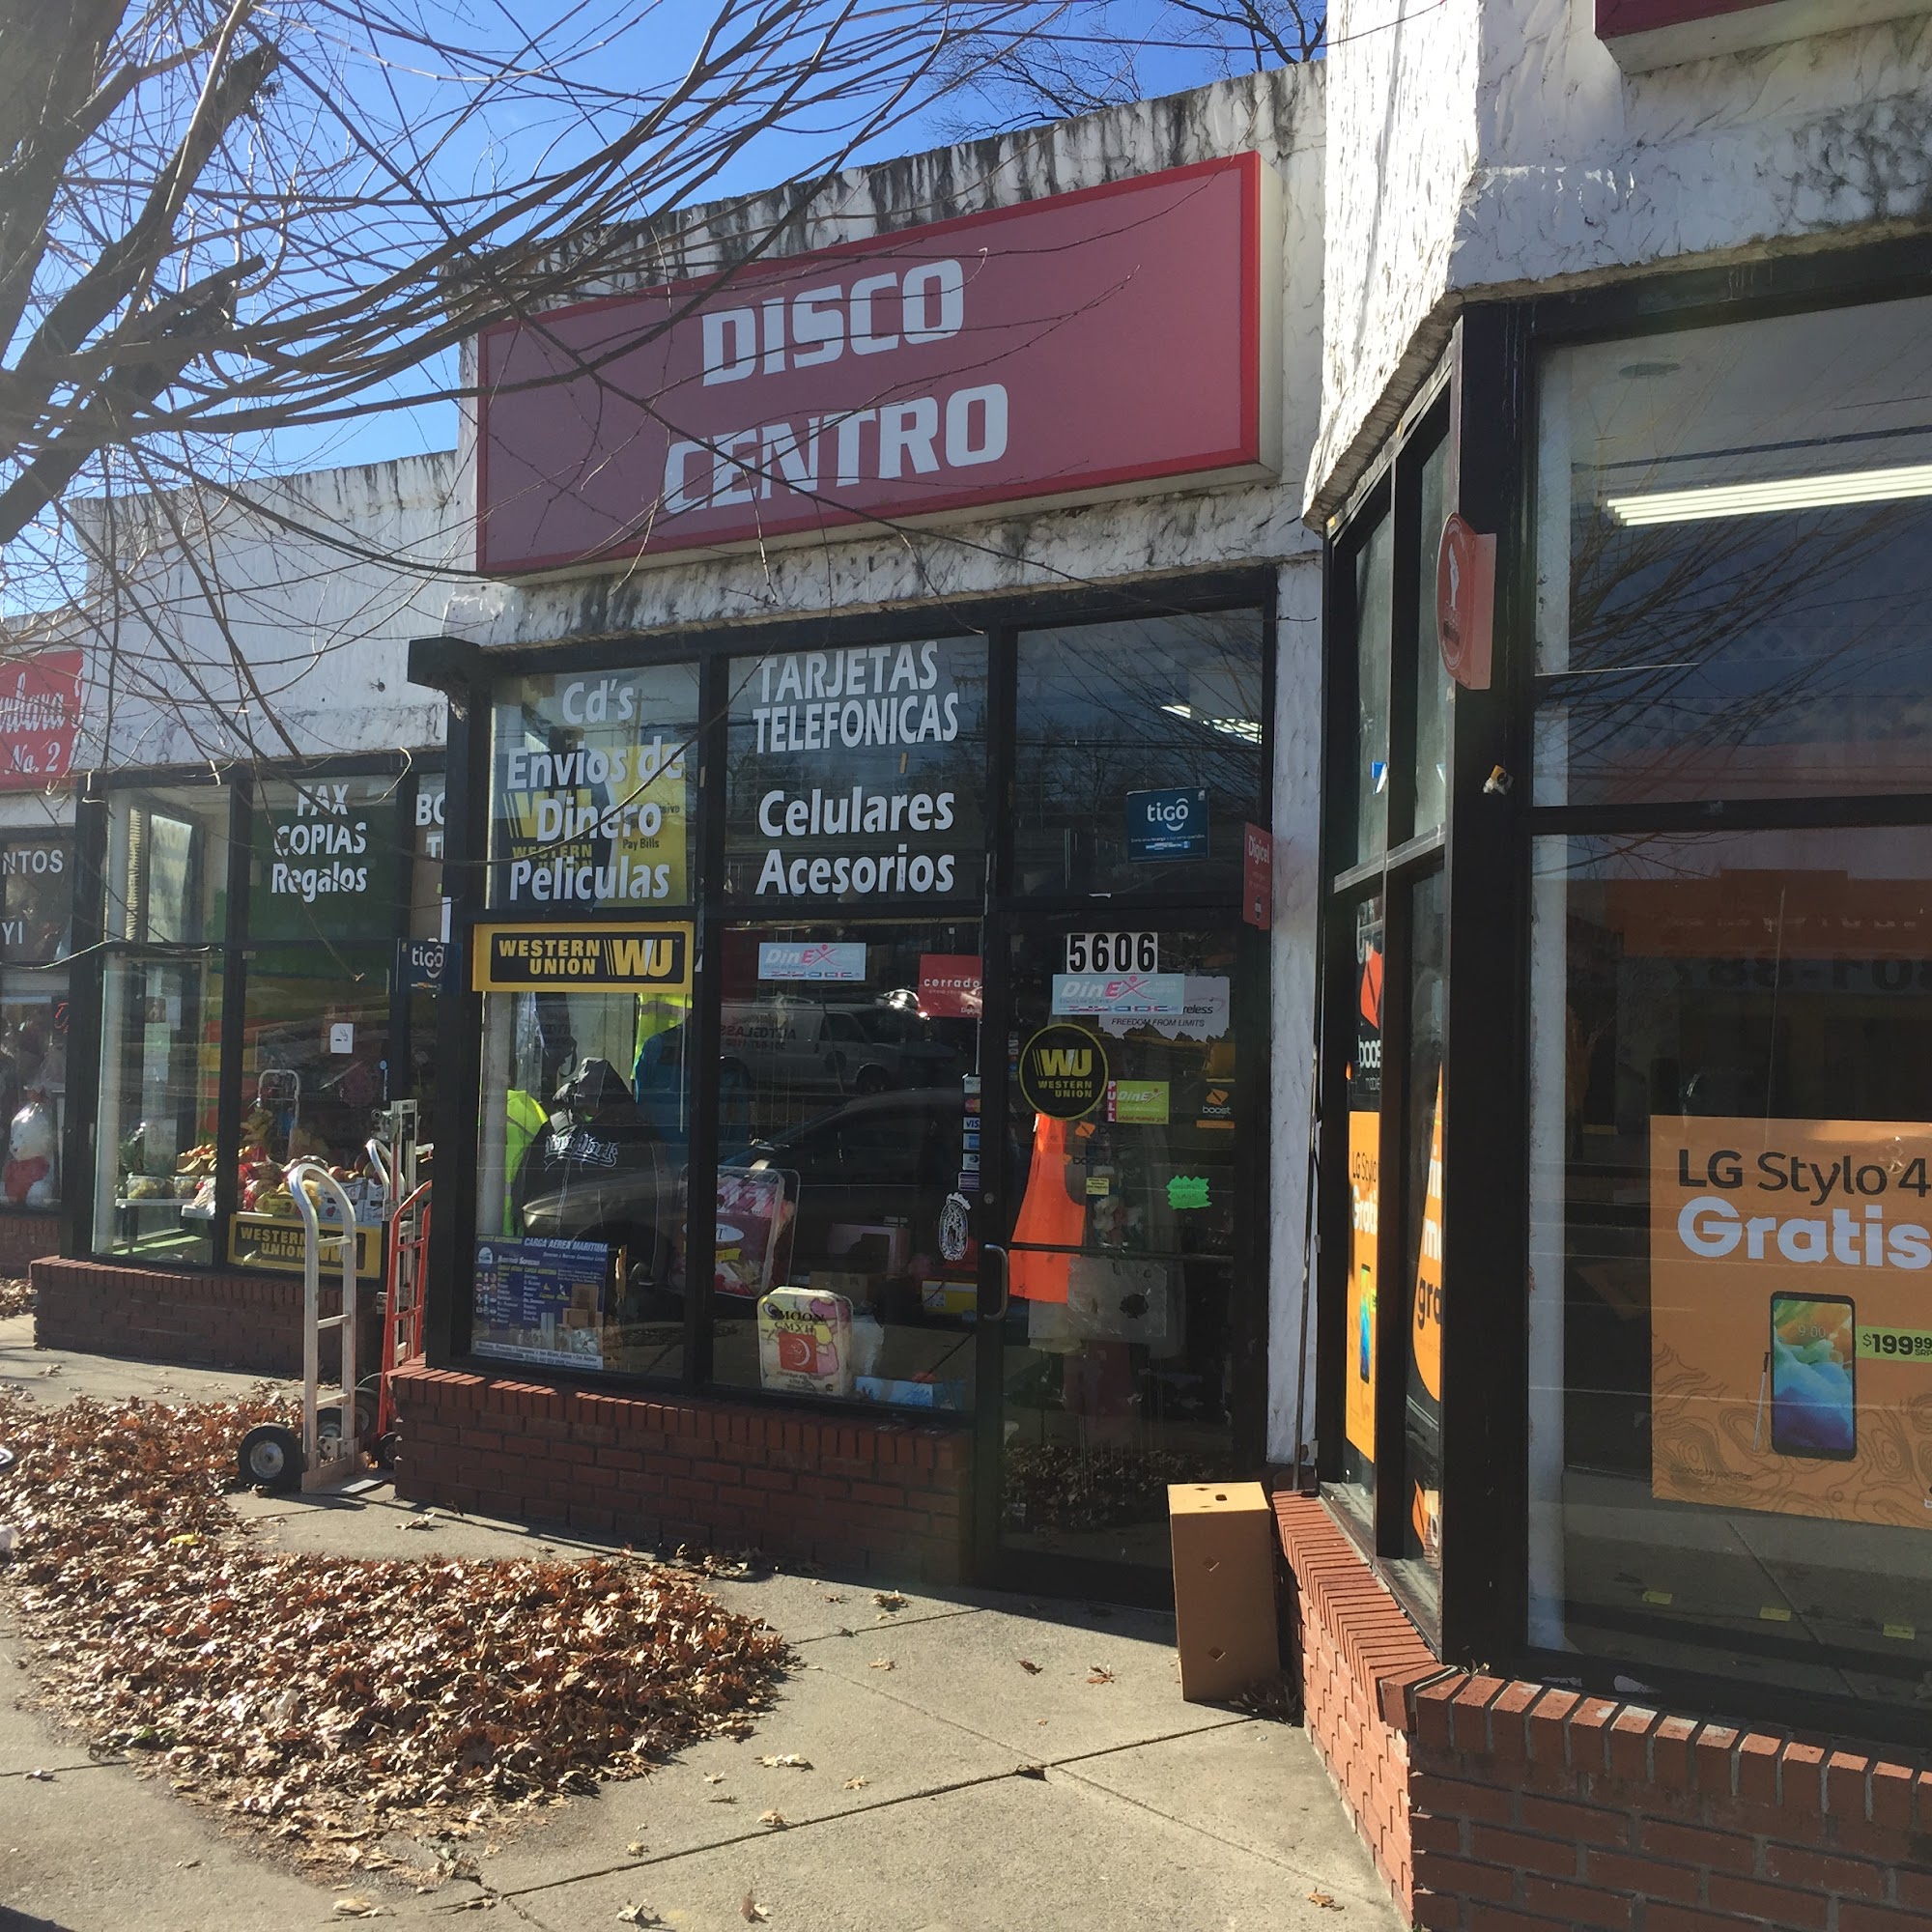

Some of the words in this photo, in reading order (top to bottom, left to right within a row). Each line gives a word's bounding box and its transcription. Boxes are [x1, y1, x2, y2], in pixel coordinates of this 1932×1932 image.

[702, 259, 964, 386] DISCO
[663, 384, 1009, 515] CENTRO
[756, 641, 938, 703] TARJETAS
[562, 679, 635, 724] Cd's
[753, 692, 959, 753] TELEFONICAS
[44, 741, 61, 773] 2
[507, 740, 628, 790] Envios
[638, 735, 687, 781] de
[297, 783, 350, 817] FAX
[758, 786, 954, 838] Celulares
[1147, 799, 1190, 826] tigo
[536, 796, 663, 842] Dinero
[273, 821, 367, 858] COPIAS
[622, 838, 639, 851] Pay
[639, 838, 660, 849] Bills
[2, 848, 65, 875] NTOS
[510, 855, 670, 901] Peliculas
[755, 844, 954, 895] Acesorios
[270, 861, 368, 904] Regalos
[411, 945, 445, 971] tigo
[498, 939, 601, 957] WESTERN
[612, 939, 674, 978] WU
[529, 958, 596, 976] UNION
[764, 945, 843, 967] DinEX
[1069, 932, 1156, 974] 5606
[923, 977, 980, 989] cerrado
[1061, 976, 1157, 1003] DinEX
[1111, 1017, 1151, 1027] FREEDOM
[1152, 1018, 1177, 1027] FROM
[1178, 1018, 1206, 1028] LIMITS
[1039, 1048, 1093, 1077] WU
[1037, 1080, 1094, 1090] WESTERN
[1054, 1089, 1094, 1098] UNION
[1107, 1080, 1117, 1122] PULL
[1202, 1105, 1232, 1115] boost
[1678, 1149, 1743, 1189] LG
[1756, 1151, 1888, 1207] Stylo
[1897, 1157, 1932, 1198] 4
[260, 1241, 306, 1260] UNION
[1677, 1195, 1932, 1269] Gratis
